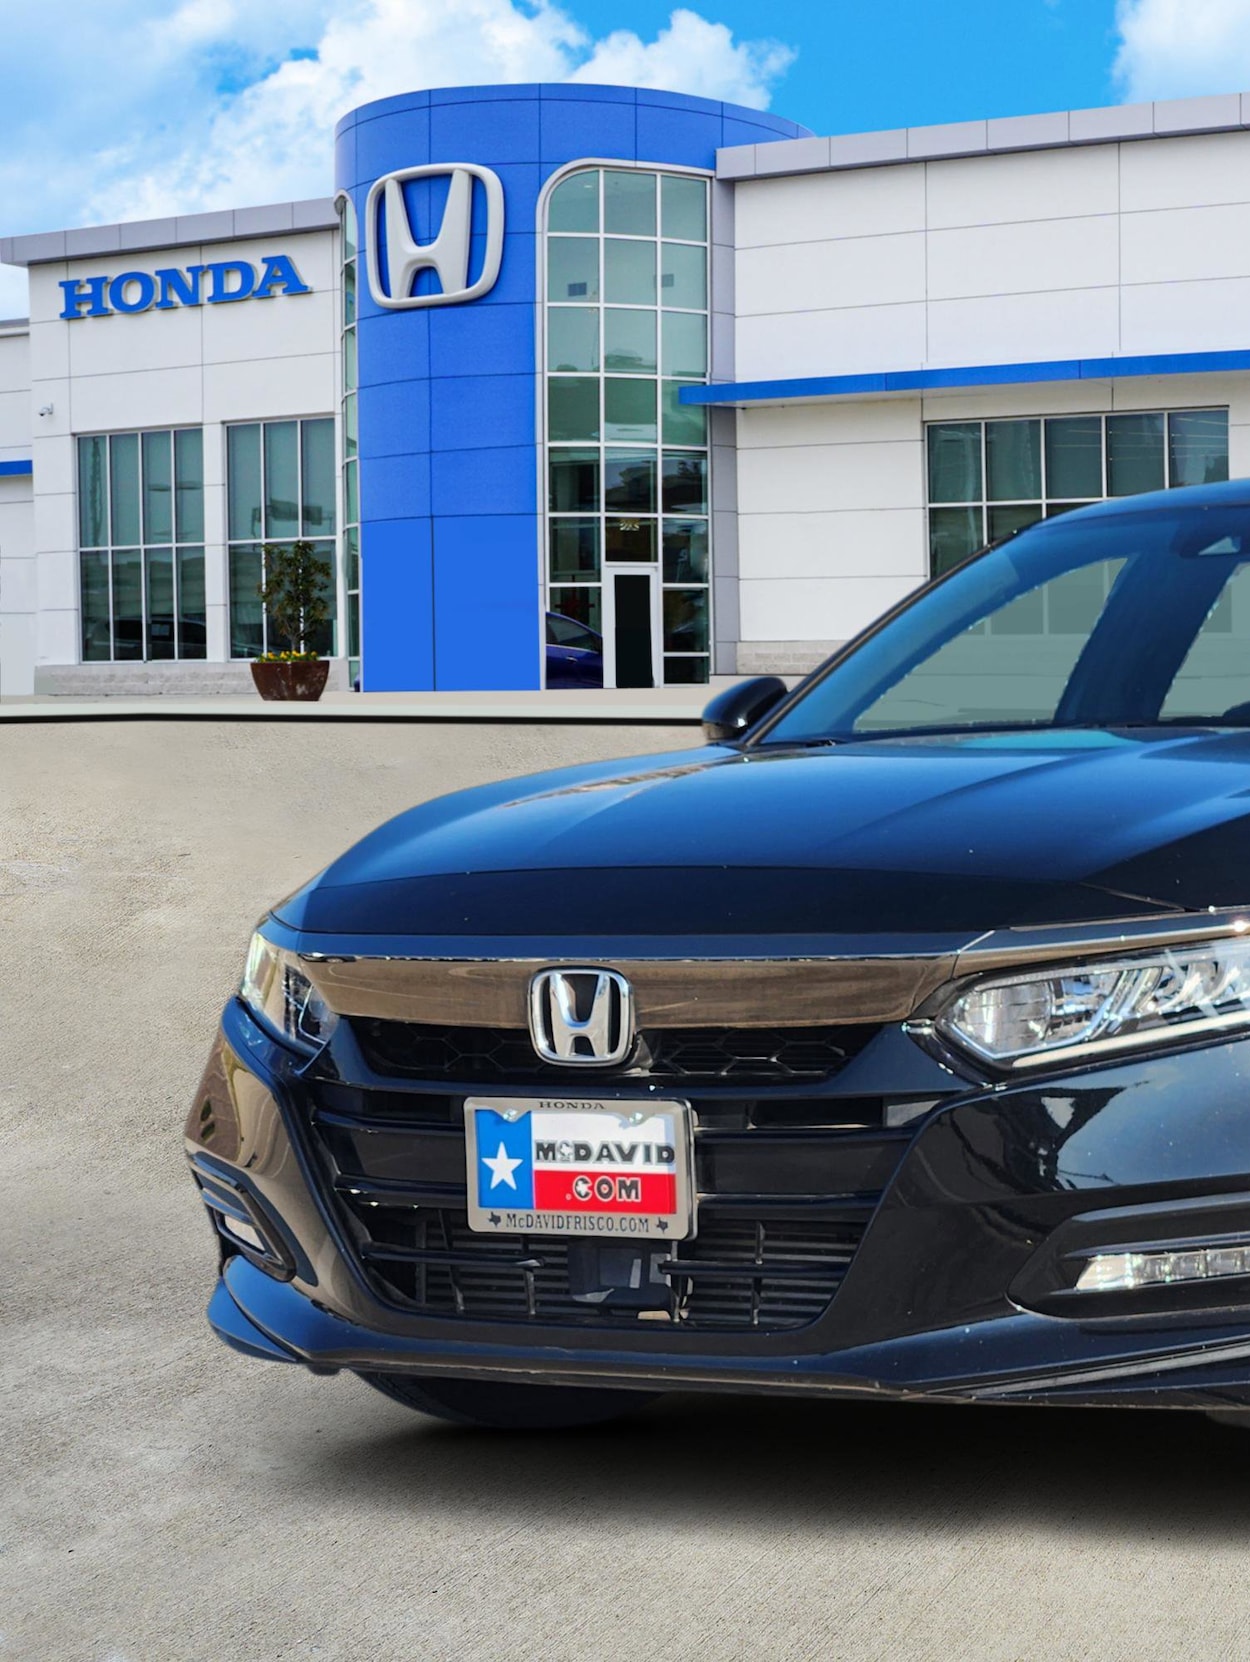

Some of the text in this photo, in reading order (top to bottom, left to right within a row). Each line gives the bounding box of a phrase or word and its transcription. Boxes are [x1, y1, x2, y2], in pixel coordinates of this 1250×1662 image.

[59, 255, 312, 320] HONDA
[539, 1101, 606, 1110] HONDA
[506, 1213, 649, 1233] McDAVIDFRISCO.COM
